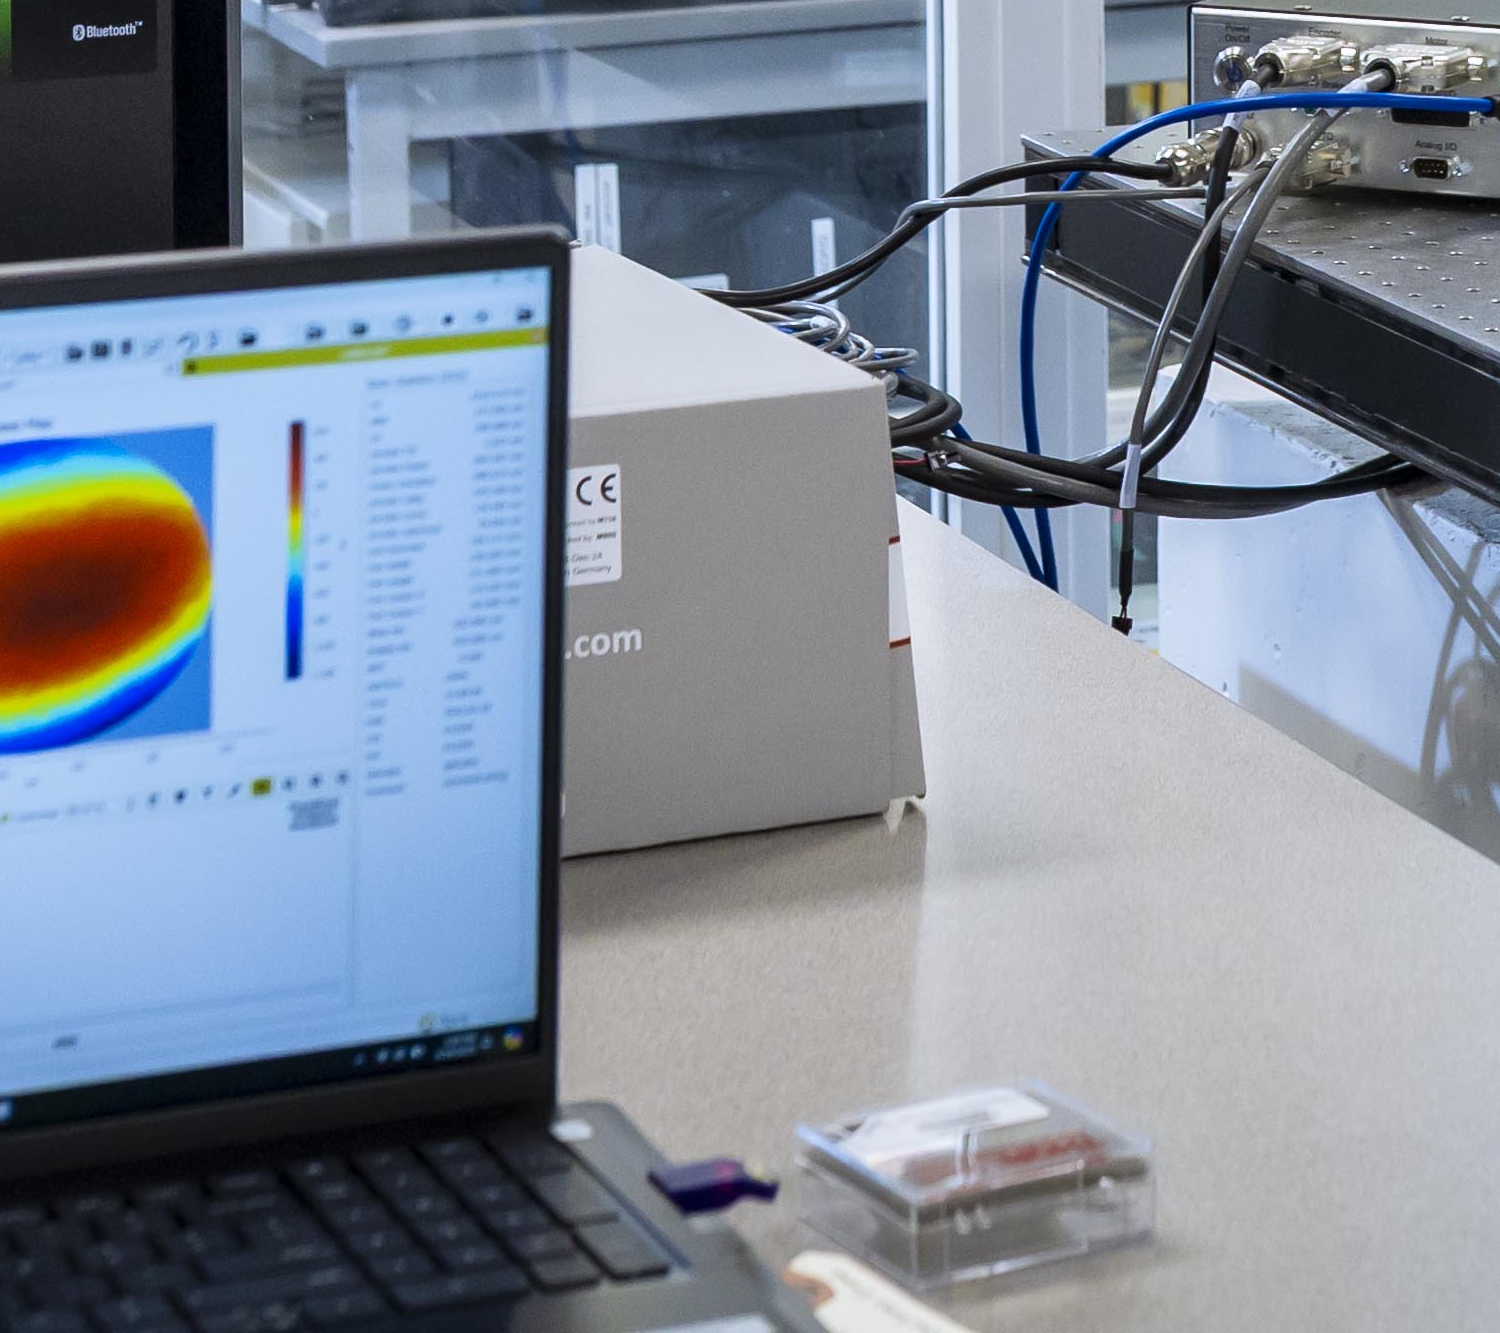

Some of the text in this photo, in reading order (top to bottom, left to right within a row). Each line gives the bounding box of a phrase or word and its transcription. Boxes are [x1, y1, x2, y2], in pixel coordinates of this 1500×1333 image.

[1425, 36, 1449, 46] Motor
[1415, 140, 1443, 152] Analog
[575, 472, 617, 506] CE
